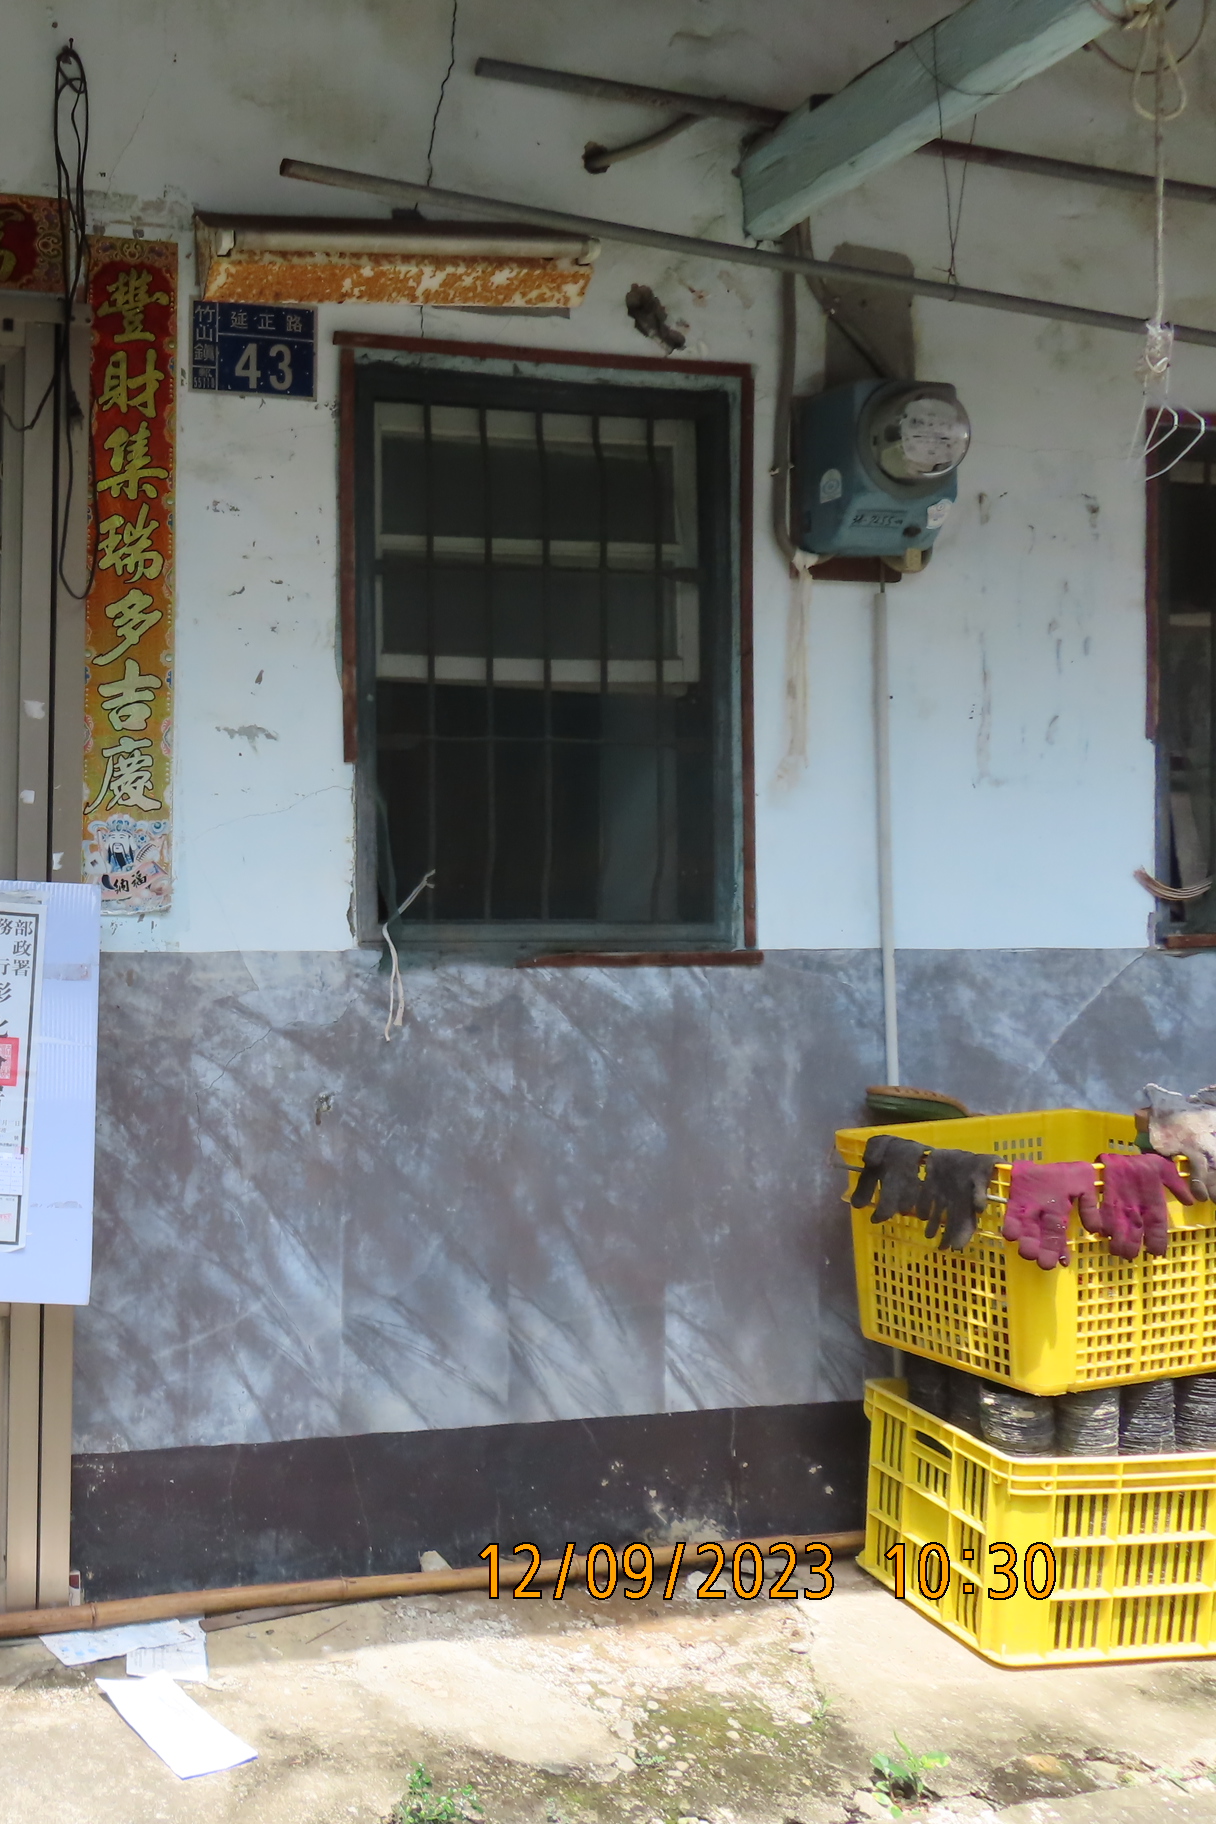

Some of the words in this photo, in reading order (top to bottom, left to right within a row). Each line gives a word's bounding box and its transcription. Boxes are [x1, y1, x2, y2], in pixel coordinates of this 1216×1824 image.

[230, 310, 303, 333] 延正路
[234, 342, 293, 391] 43
[113, 870, 148, 895] 納福
